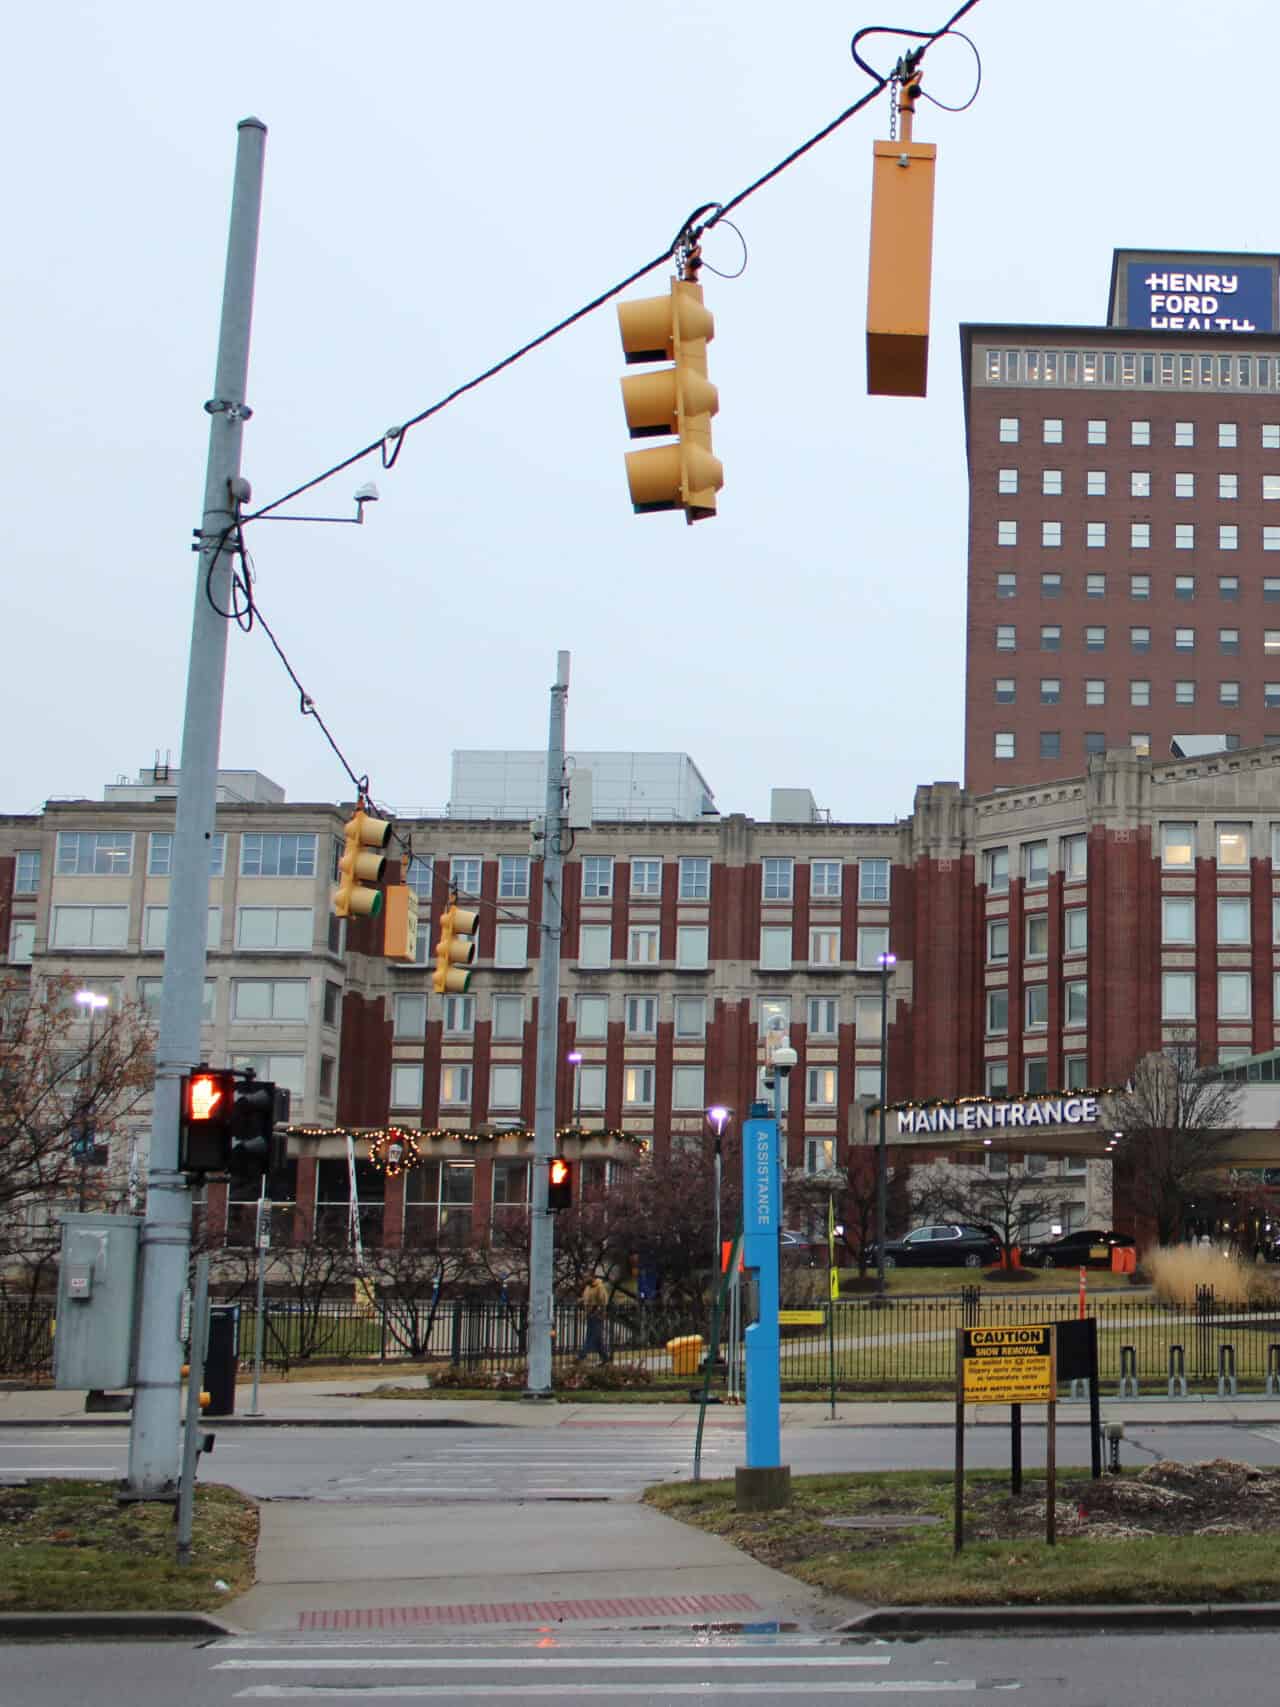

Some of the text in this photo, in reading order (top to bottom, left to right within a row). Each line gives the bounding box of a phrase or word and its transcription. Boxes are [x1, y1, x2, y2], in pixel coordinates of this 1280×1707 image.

[1145, 272, 1238, 294] HENRY
[1150, 294, 1219, 315] FORD
[897, 1098, 1098, 1134] MAIN ENTRANCE
[757, 1131, 769, 1224] ASSISTANCE
[974, 1331, 1040, 1344] CAUTION
[976, 1345, 1039, 1357] SNOW REMOVAL
